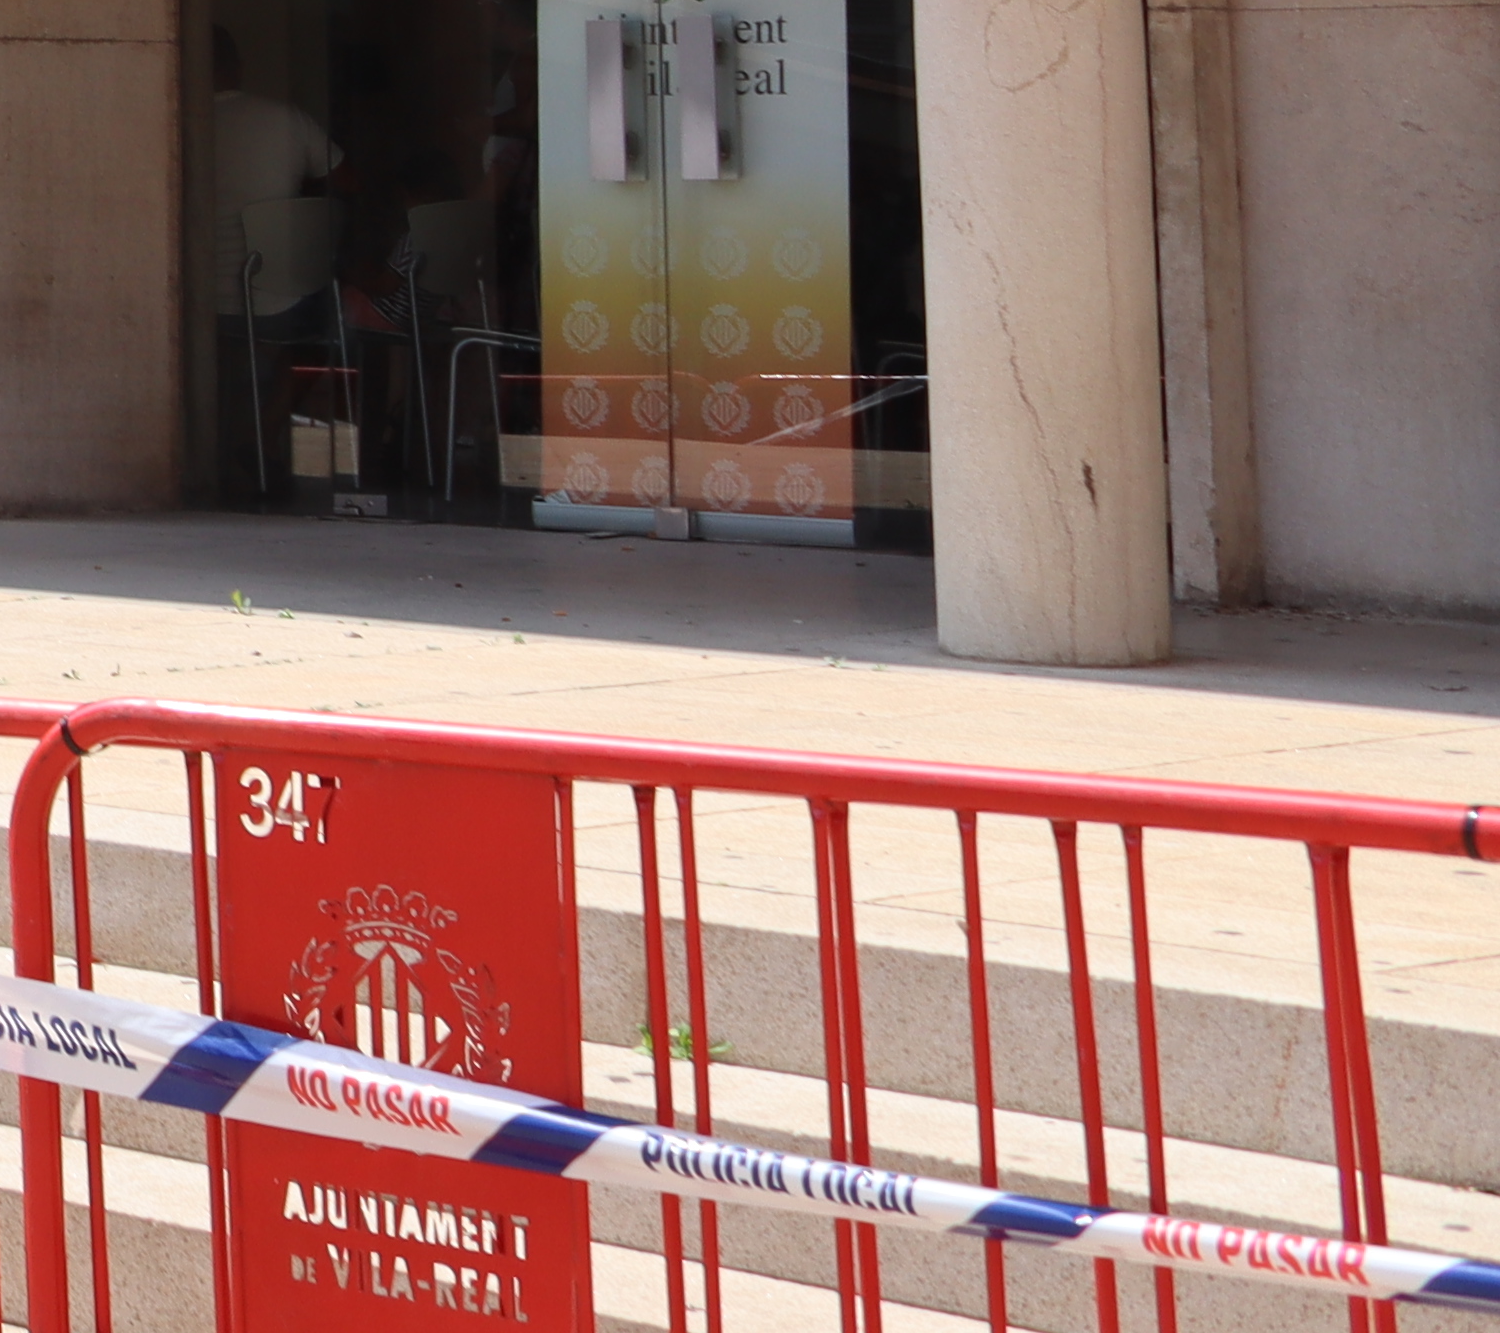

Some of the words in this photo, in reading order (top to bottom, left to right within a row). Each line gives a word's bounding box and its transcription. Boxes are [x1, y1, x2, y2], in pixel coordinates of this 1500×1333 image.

[33, 1010, 138, 1071] LOCAL
[286, 1065, 337, 1112] NO
[341, 1076, 462, 1137] PASAR
[282, 1179, 530, 1261] AJUNTAMENT
[1142, 1216, 1204, 1262] NO
[1217, 1225, 1370, 1286] PASAR
[290, 1253, 317, 1284] DE
